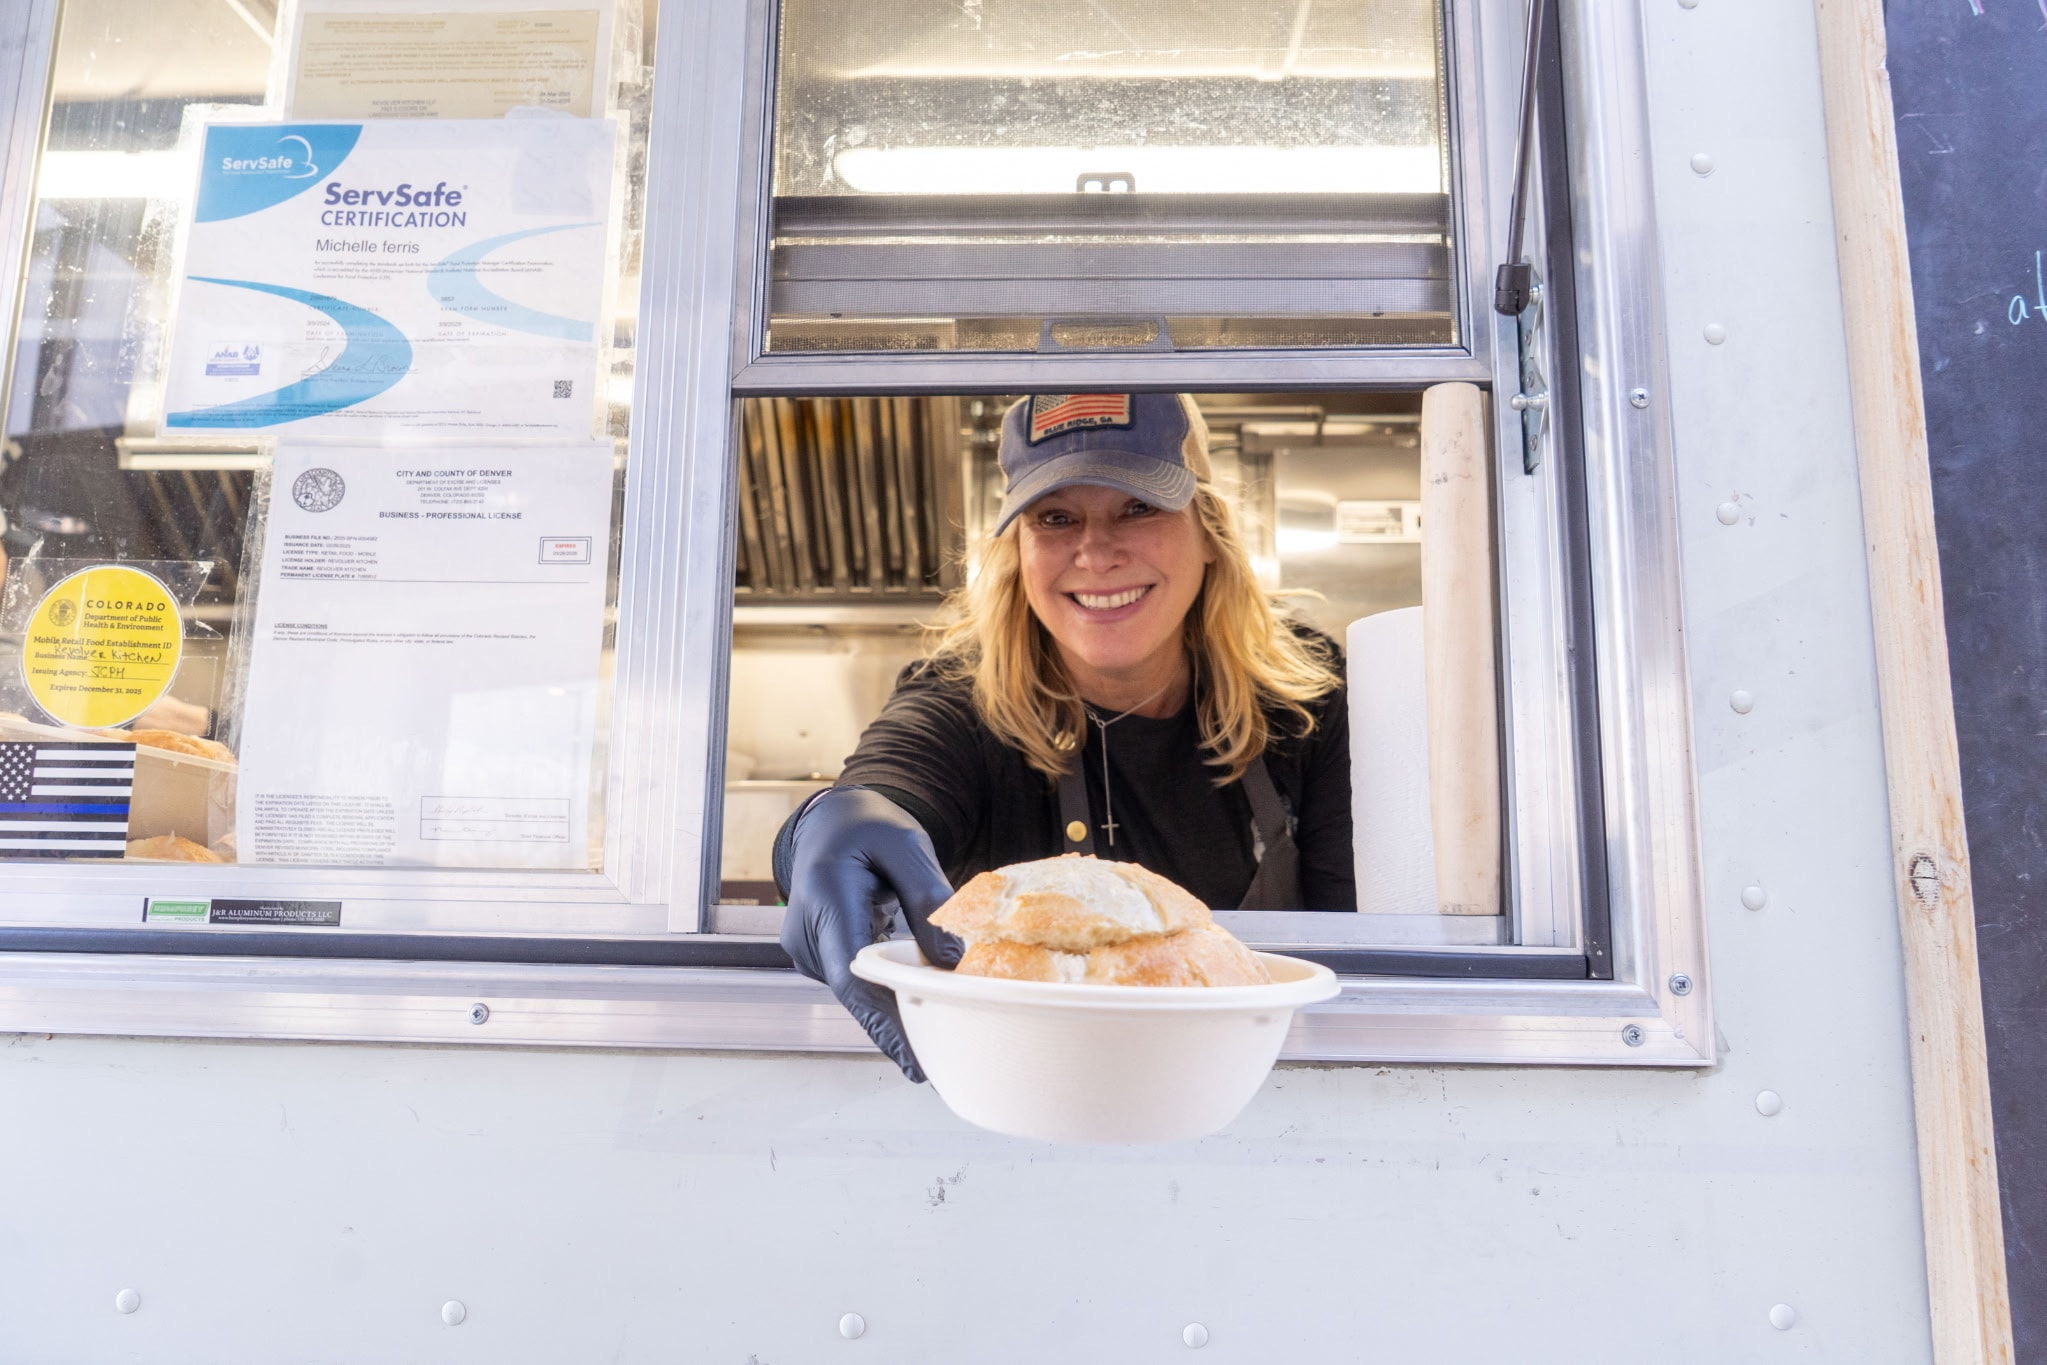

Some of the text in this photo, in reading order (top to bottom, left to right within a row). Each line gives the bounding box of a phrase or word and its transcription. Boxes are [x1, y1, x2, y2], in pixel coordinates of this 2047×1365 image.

[222, 156, 292, 170] ServSafe
[324, 182, 462, 207] ServSafe
[321, 210, 467, 227] CERTIFICATION
[315, 239, 420, 253] Michelle ferris
[1044, 423, 1064, 435] BLUE
[86, 600, 166, 611] COLORADO
[84, 613, 162, 624] Department of Public
[116, 623, 164, 631] Environment
[34, 636, 60, 644] Mobile
[107, 640, 161, 648] Establishment
[32, 667, 57, 675] Issuing
[50, 684, 77, 693] Expires
[79, 685, 113, 693] December
